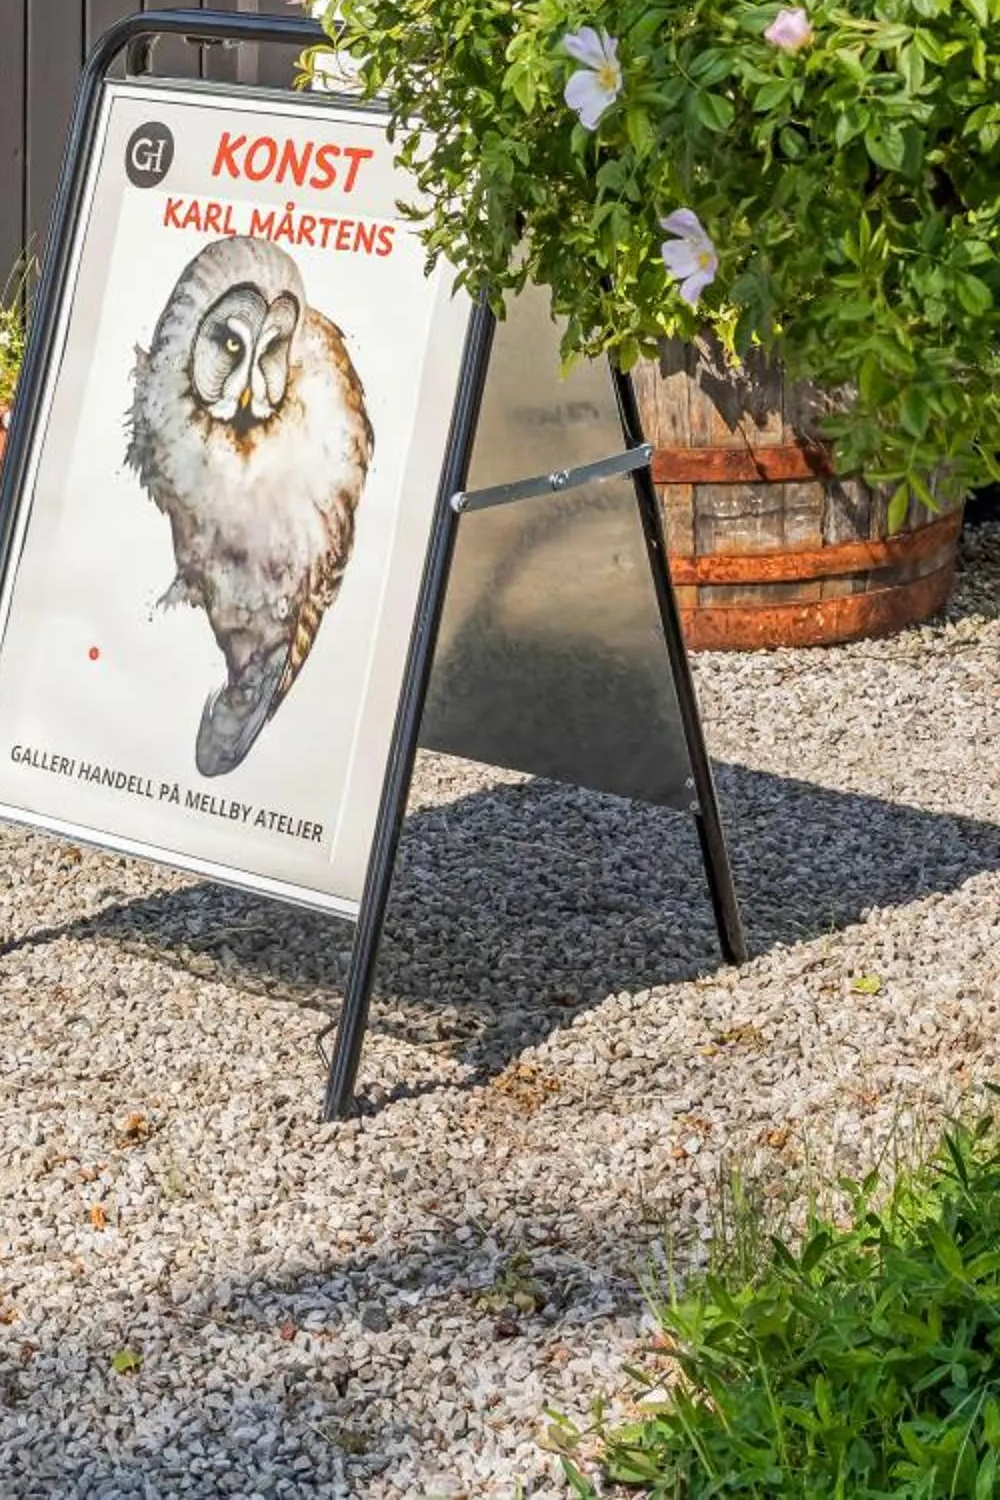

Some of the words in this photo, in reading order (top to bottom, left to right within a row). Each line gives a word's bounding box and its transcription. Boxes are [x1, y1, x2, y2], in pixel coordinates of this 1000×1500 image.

[211, 132, 374, 192] KONST
[163, 198, 237, 235] KARL
[249, 202, 396, 257] MÅRTENS
[10, 745, 75, 777] GALLERI
[78, 762, 153, 798] HANDELL
[159, 781, 181, 805] PÅ
[184, 789, 253, 824] MELLBY
[253, 809, 324, 843] ATELIER
